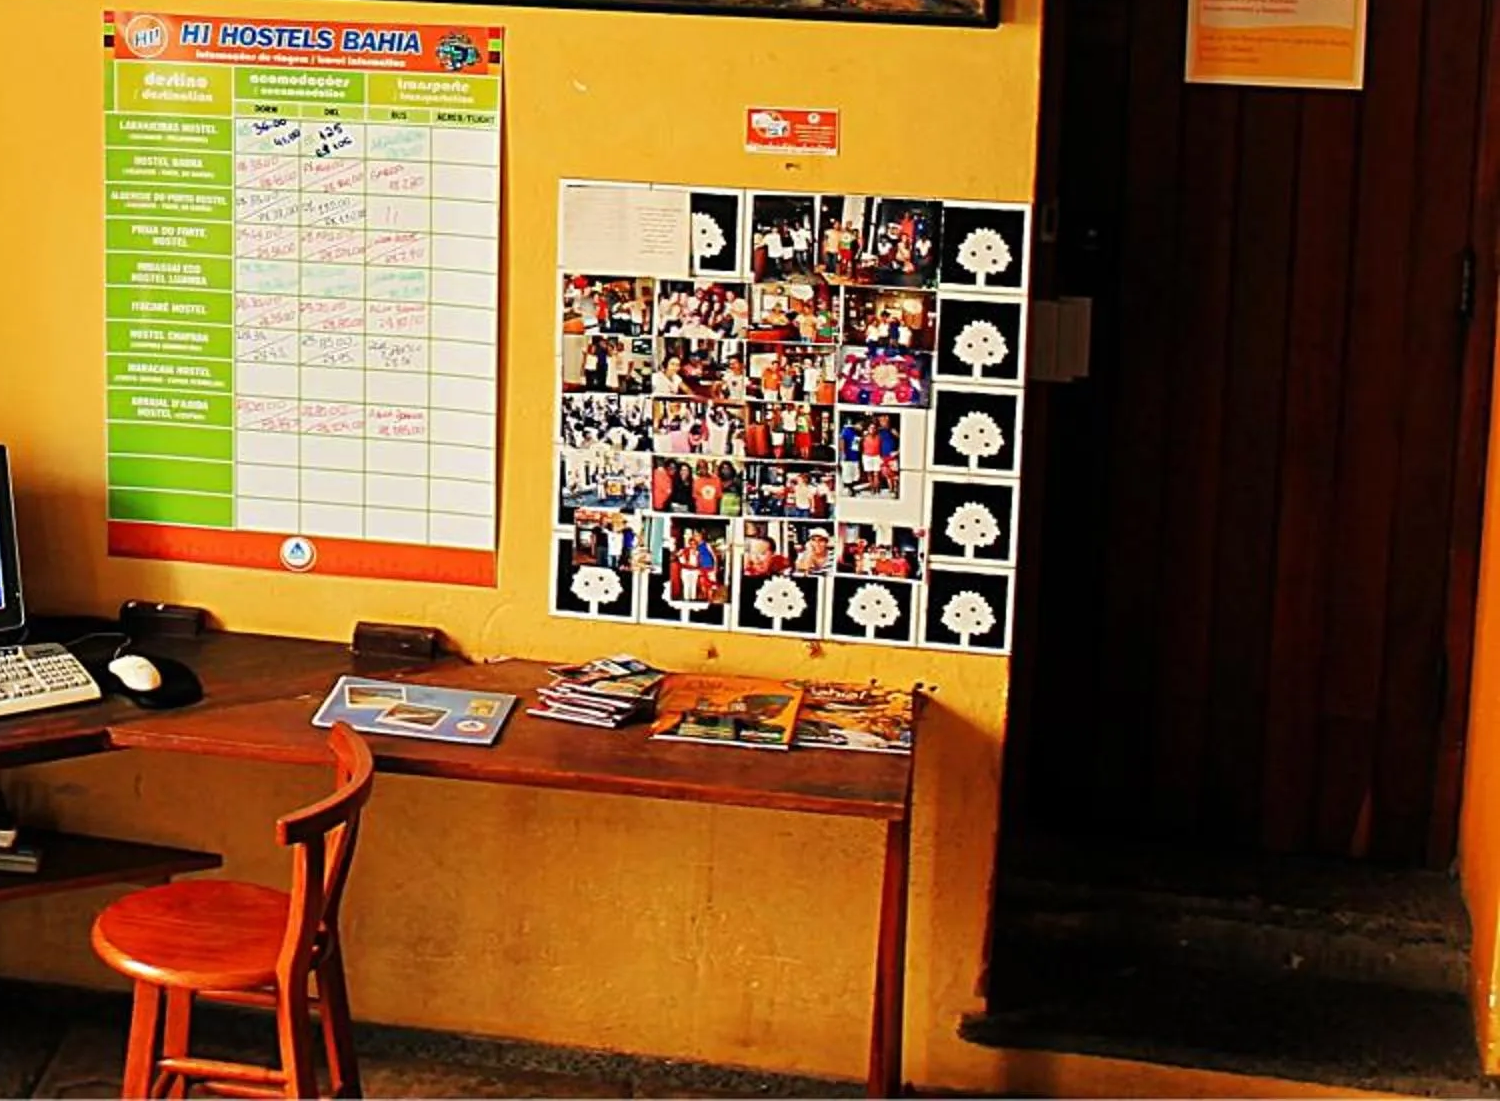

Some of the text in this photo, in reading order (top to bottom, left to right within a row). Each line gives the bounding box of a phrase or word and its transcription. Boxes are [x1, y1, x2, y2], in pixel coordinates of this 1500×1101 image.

[181, 21, 423, 55] HI HOSTELS BAHIA
[143, 71, 209, 89] destino
